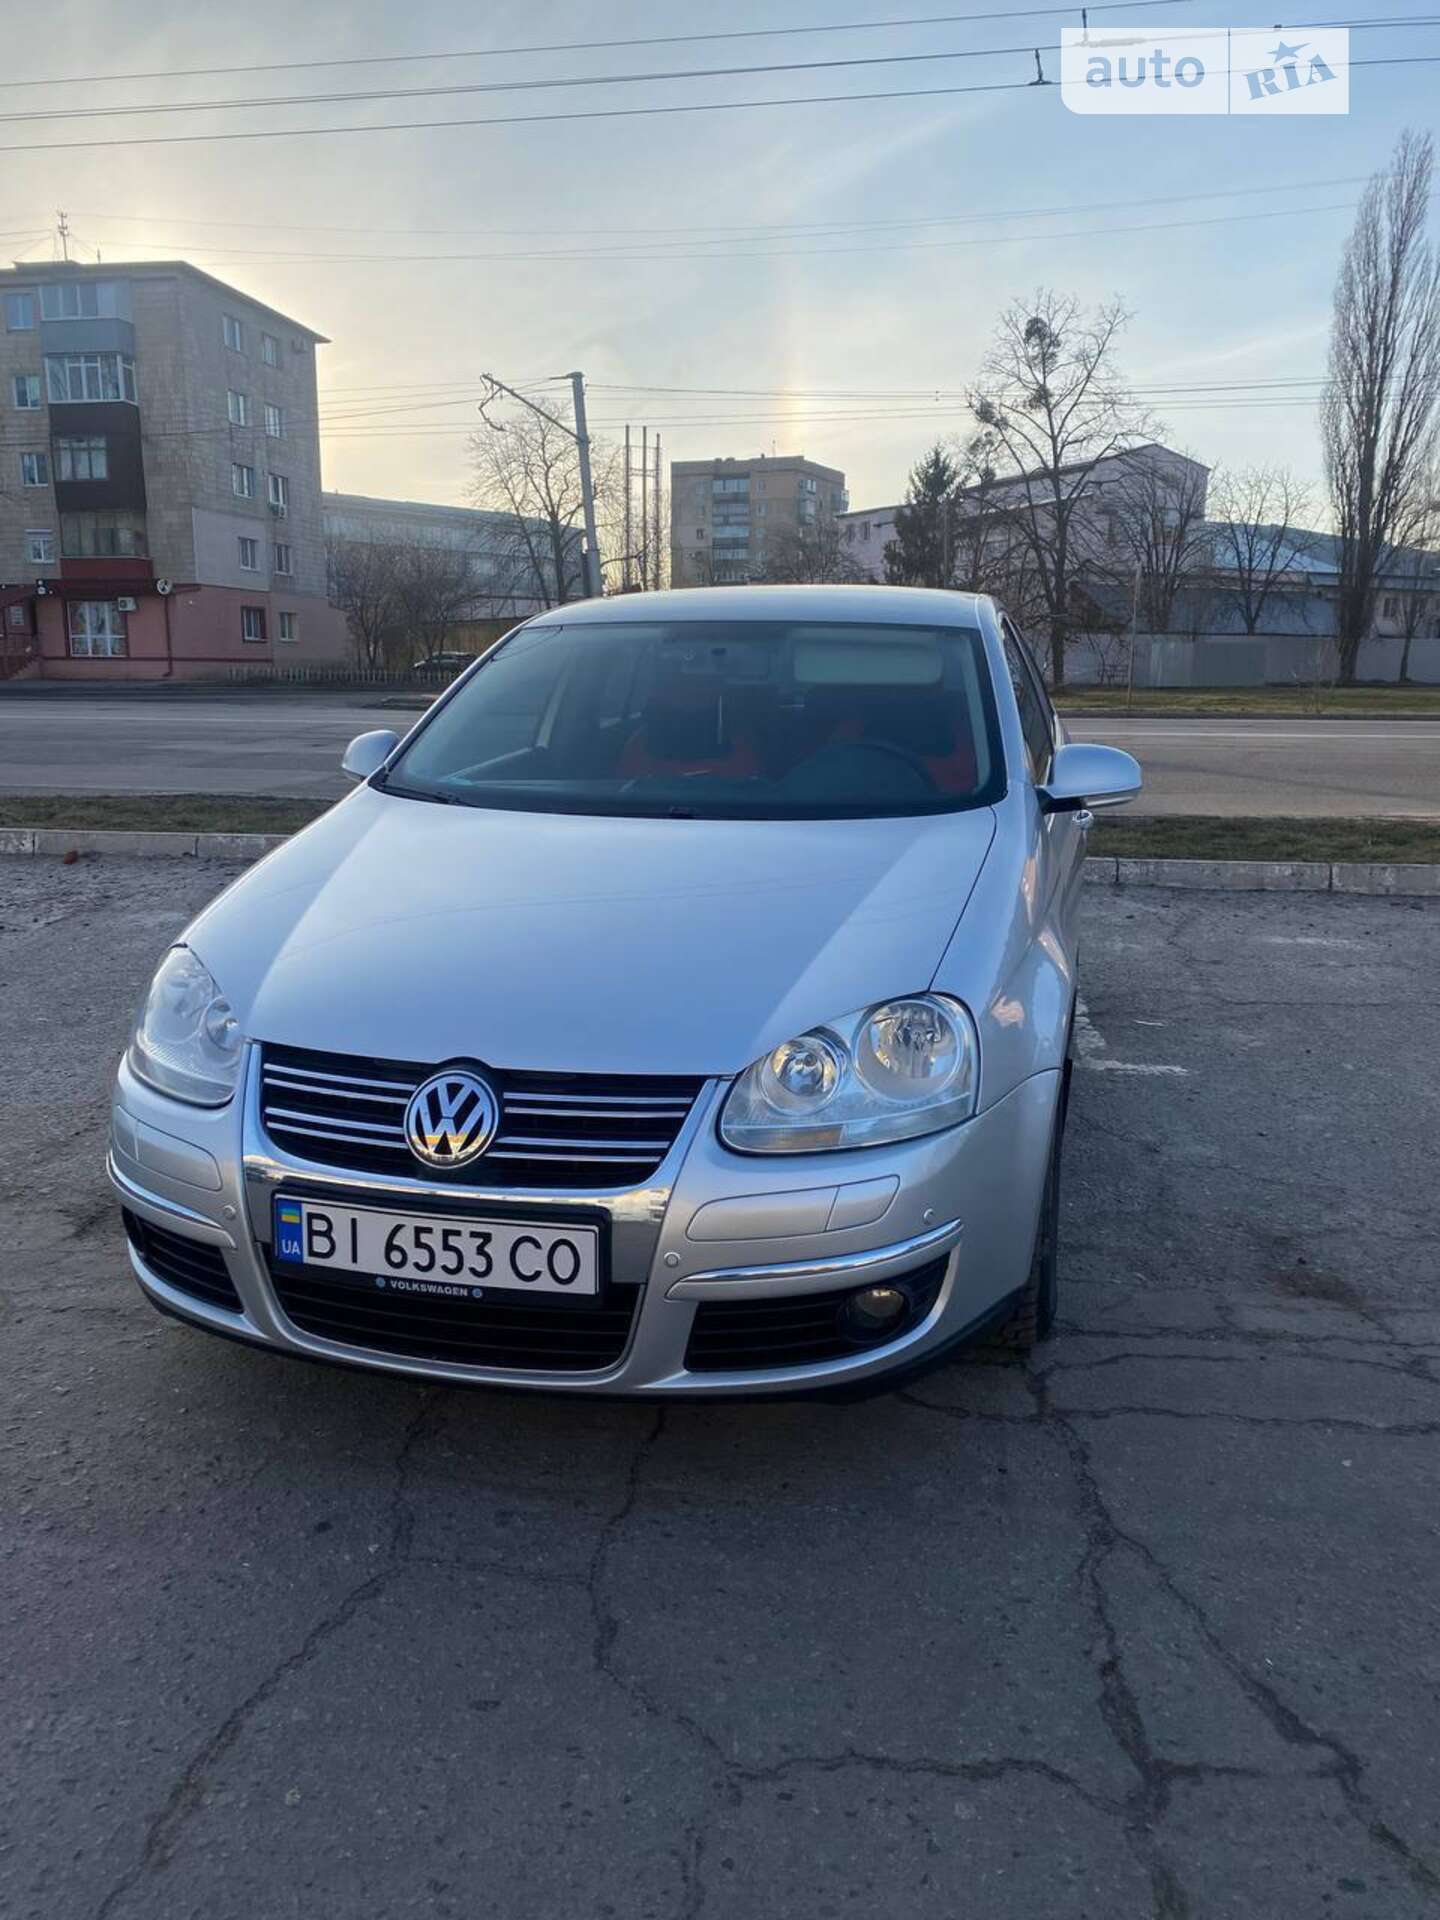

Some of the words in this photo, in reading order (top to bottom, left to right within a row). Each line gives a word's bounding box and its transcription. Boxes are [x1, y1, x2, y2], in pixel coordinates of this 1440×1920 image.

[281, 1240, 301, 1256] UA
[306, 1212, 358, 1264] BI
[385, 1223, 493, 1278] 6553
[509, 1235, 581, 1286] CO
[390, 1279, 468, 1297] VOLKSWAGEN
